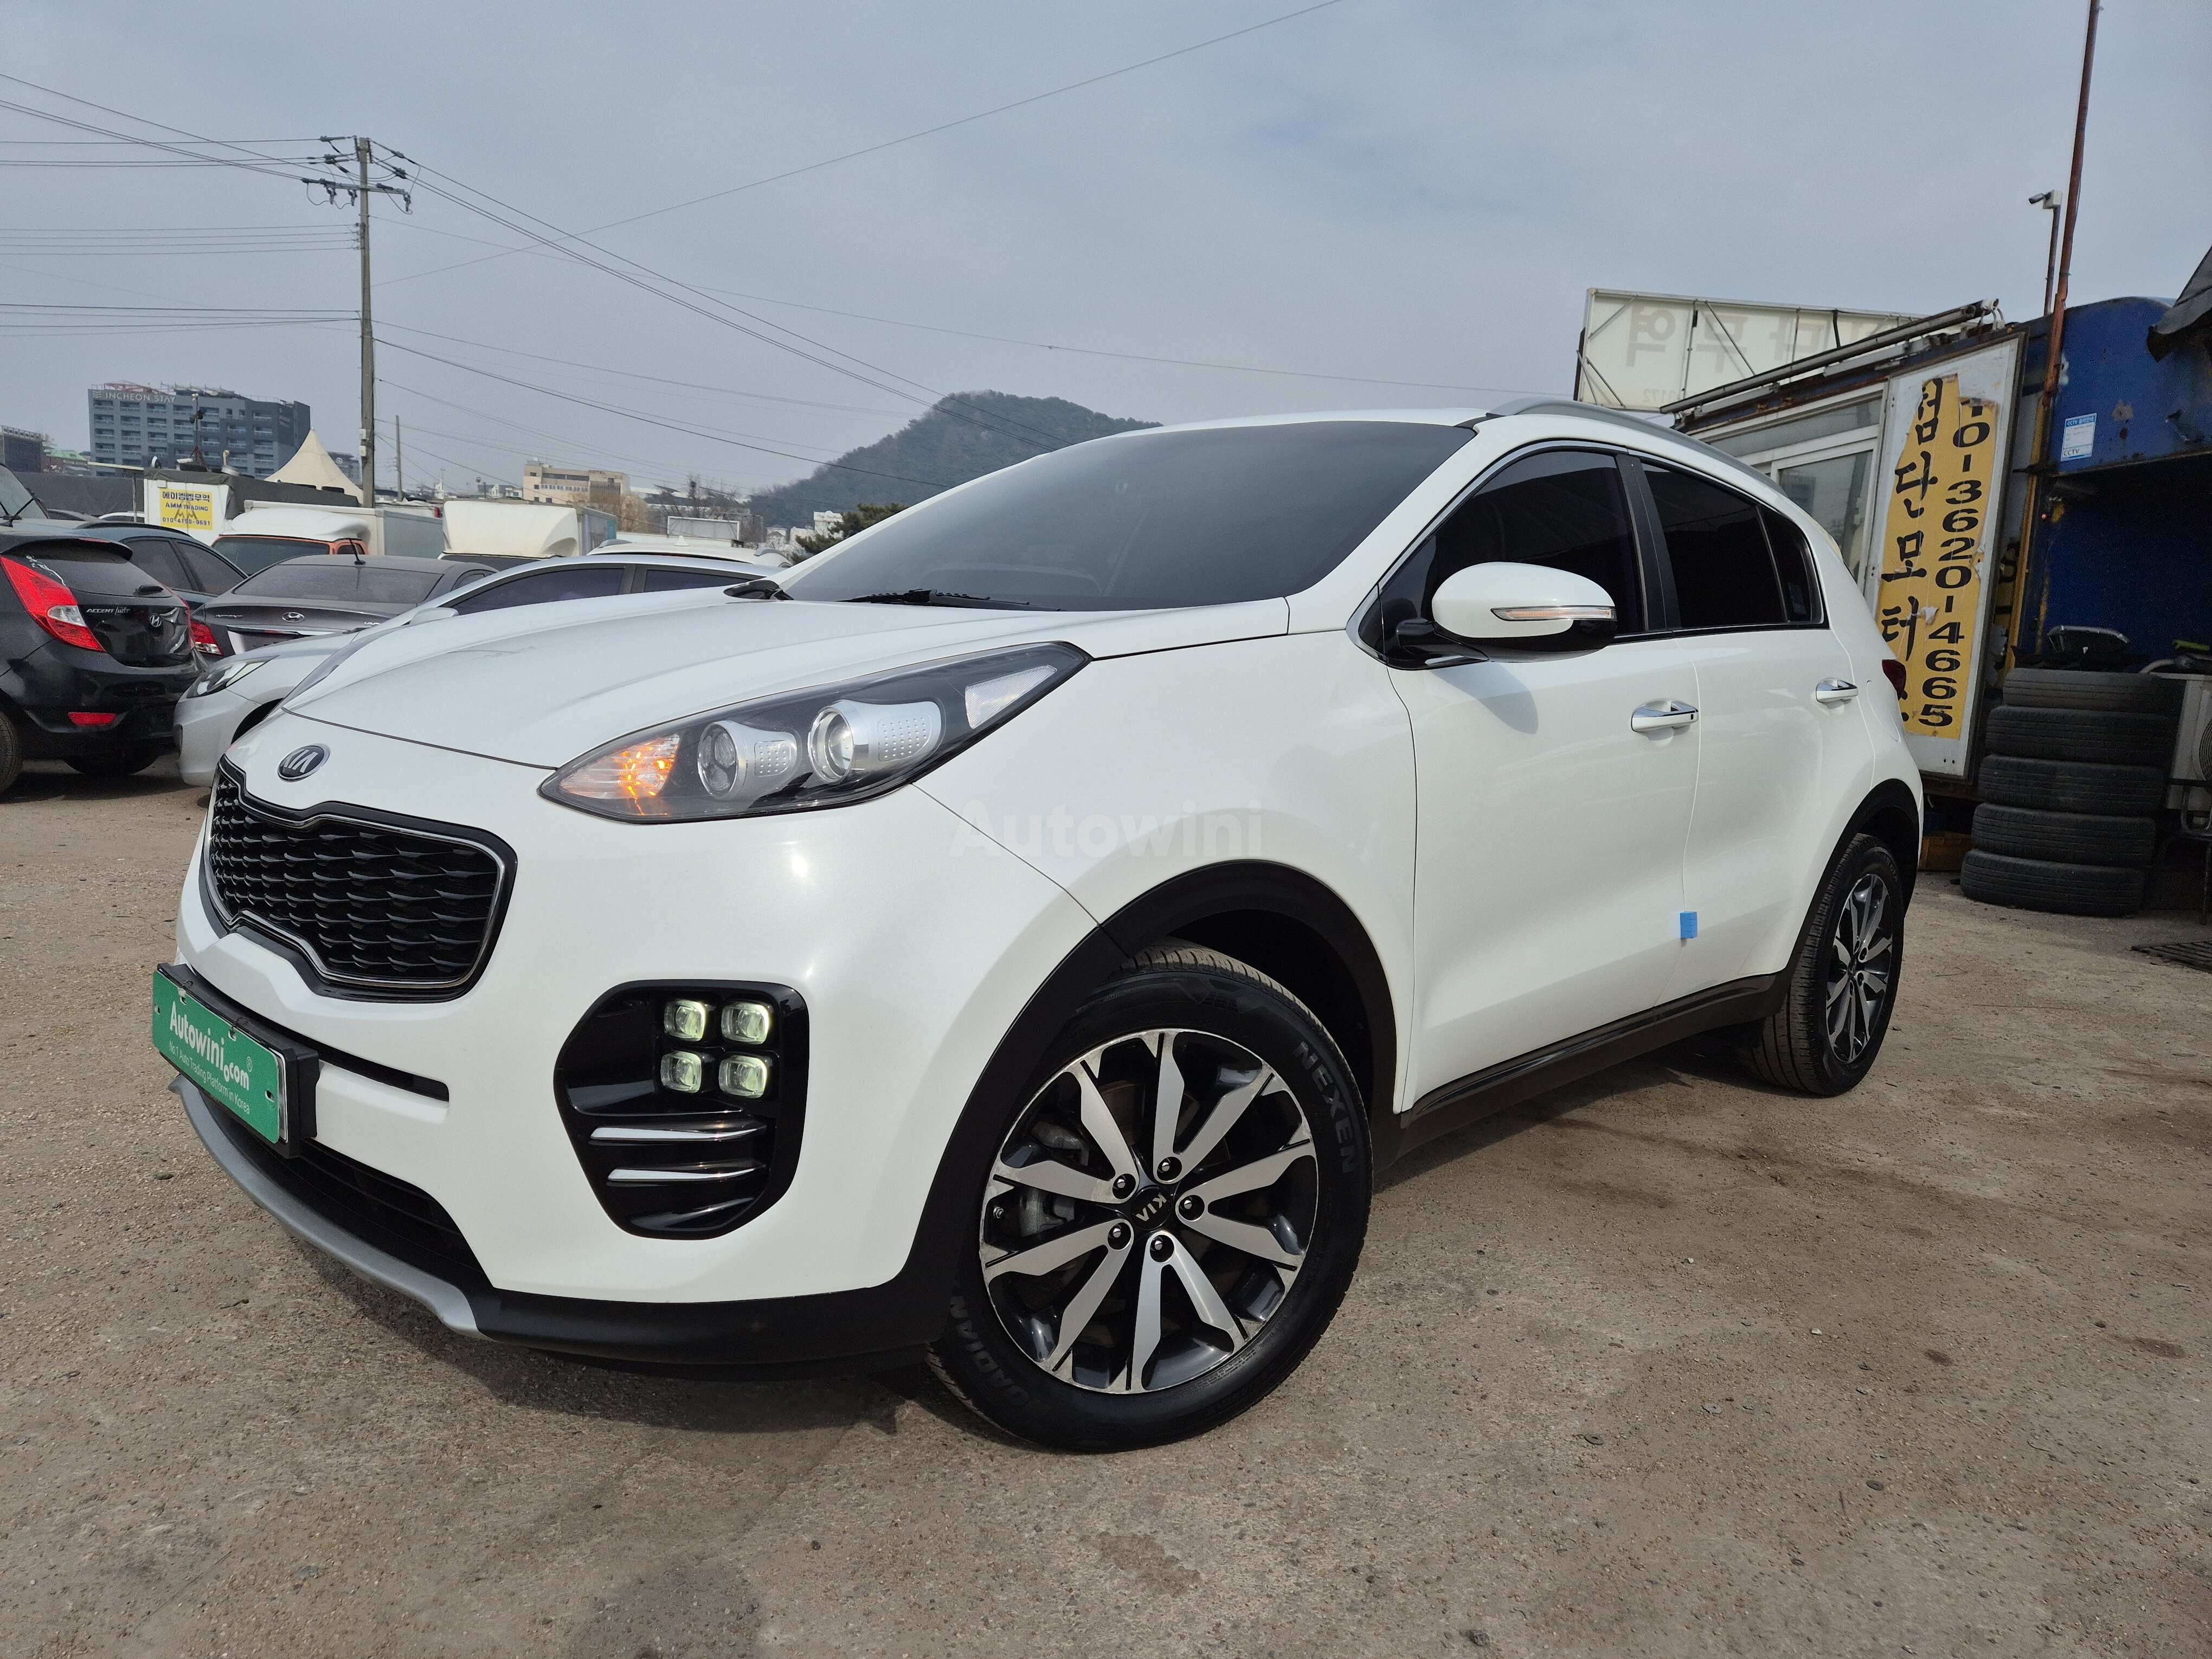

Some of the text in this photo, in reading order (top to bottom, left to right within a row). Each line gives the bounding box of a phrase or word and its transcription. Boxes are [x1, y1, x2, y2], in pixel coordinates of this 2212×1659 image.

[105, 392, 176, 403] INCHEON STAY
[2063, 448, 2080, 456] CCTV
[1881, 378, 1944, 722] 첨단모터
[280, 749, 318, 773] KIA
[169, 1040, 179, 1057] No.1
[179, 1049, 190, 1066] Auto
[189, 1057, 207, 1083] Trading
[207, 1071, 228, 1097] Platform
[234, 1094, 250, 1115] Korea
[1293, 1040, 1357, 1174] NEXEN
[1135, 1191, 1168, 1222] KIA
